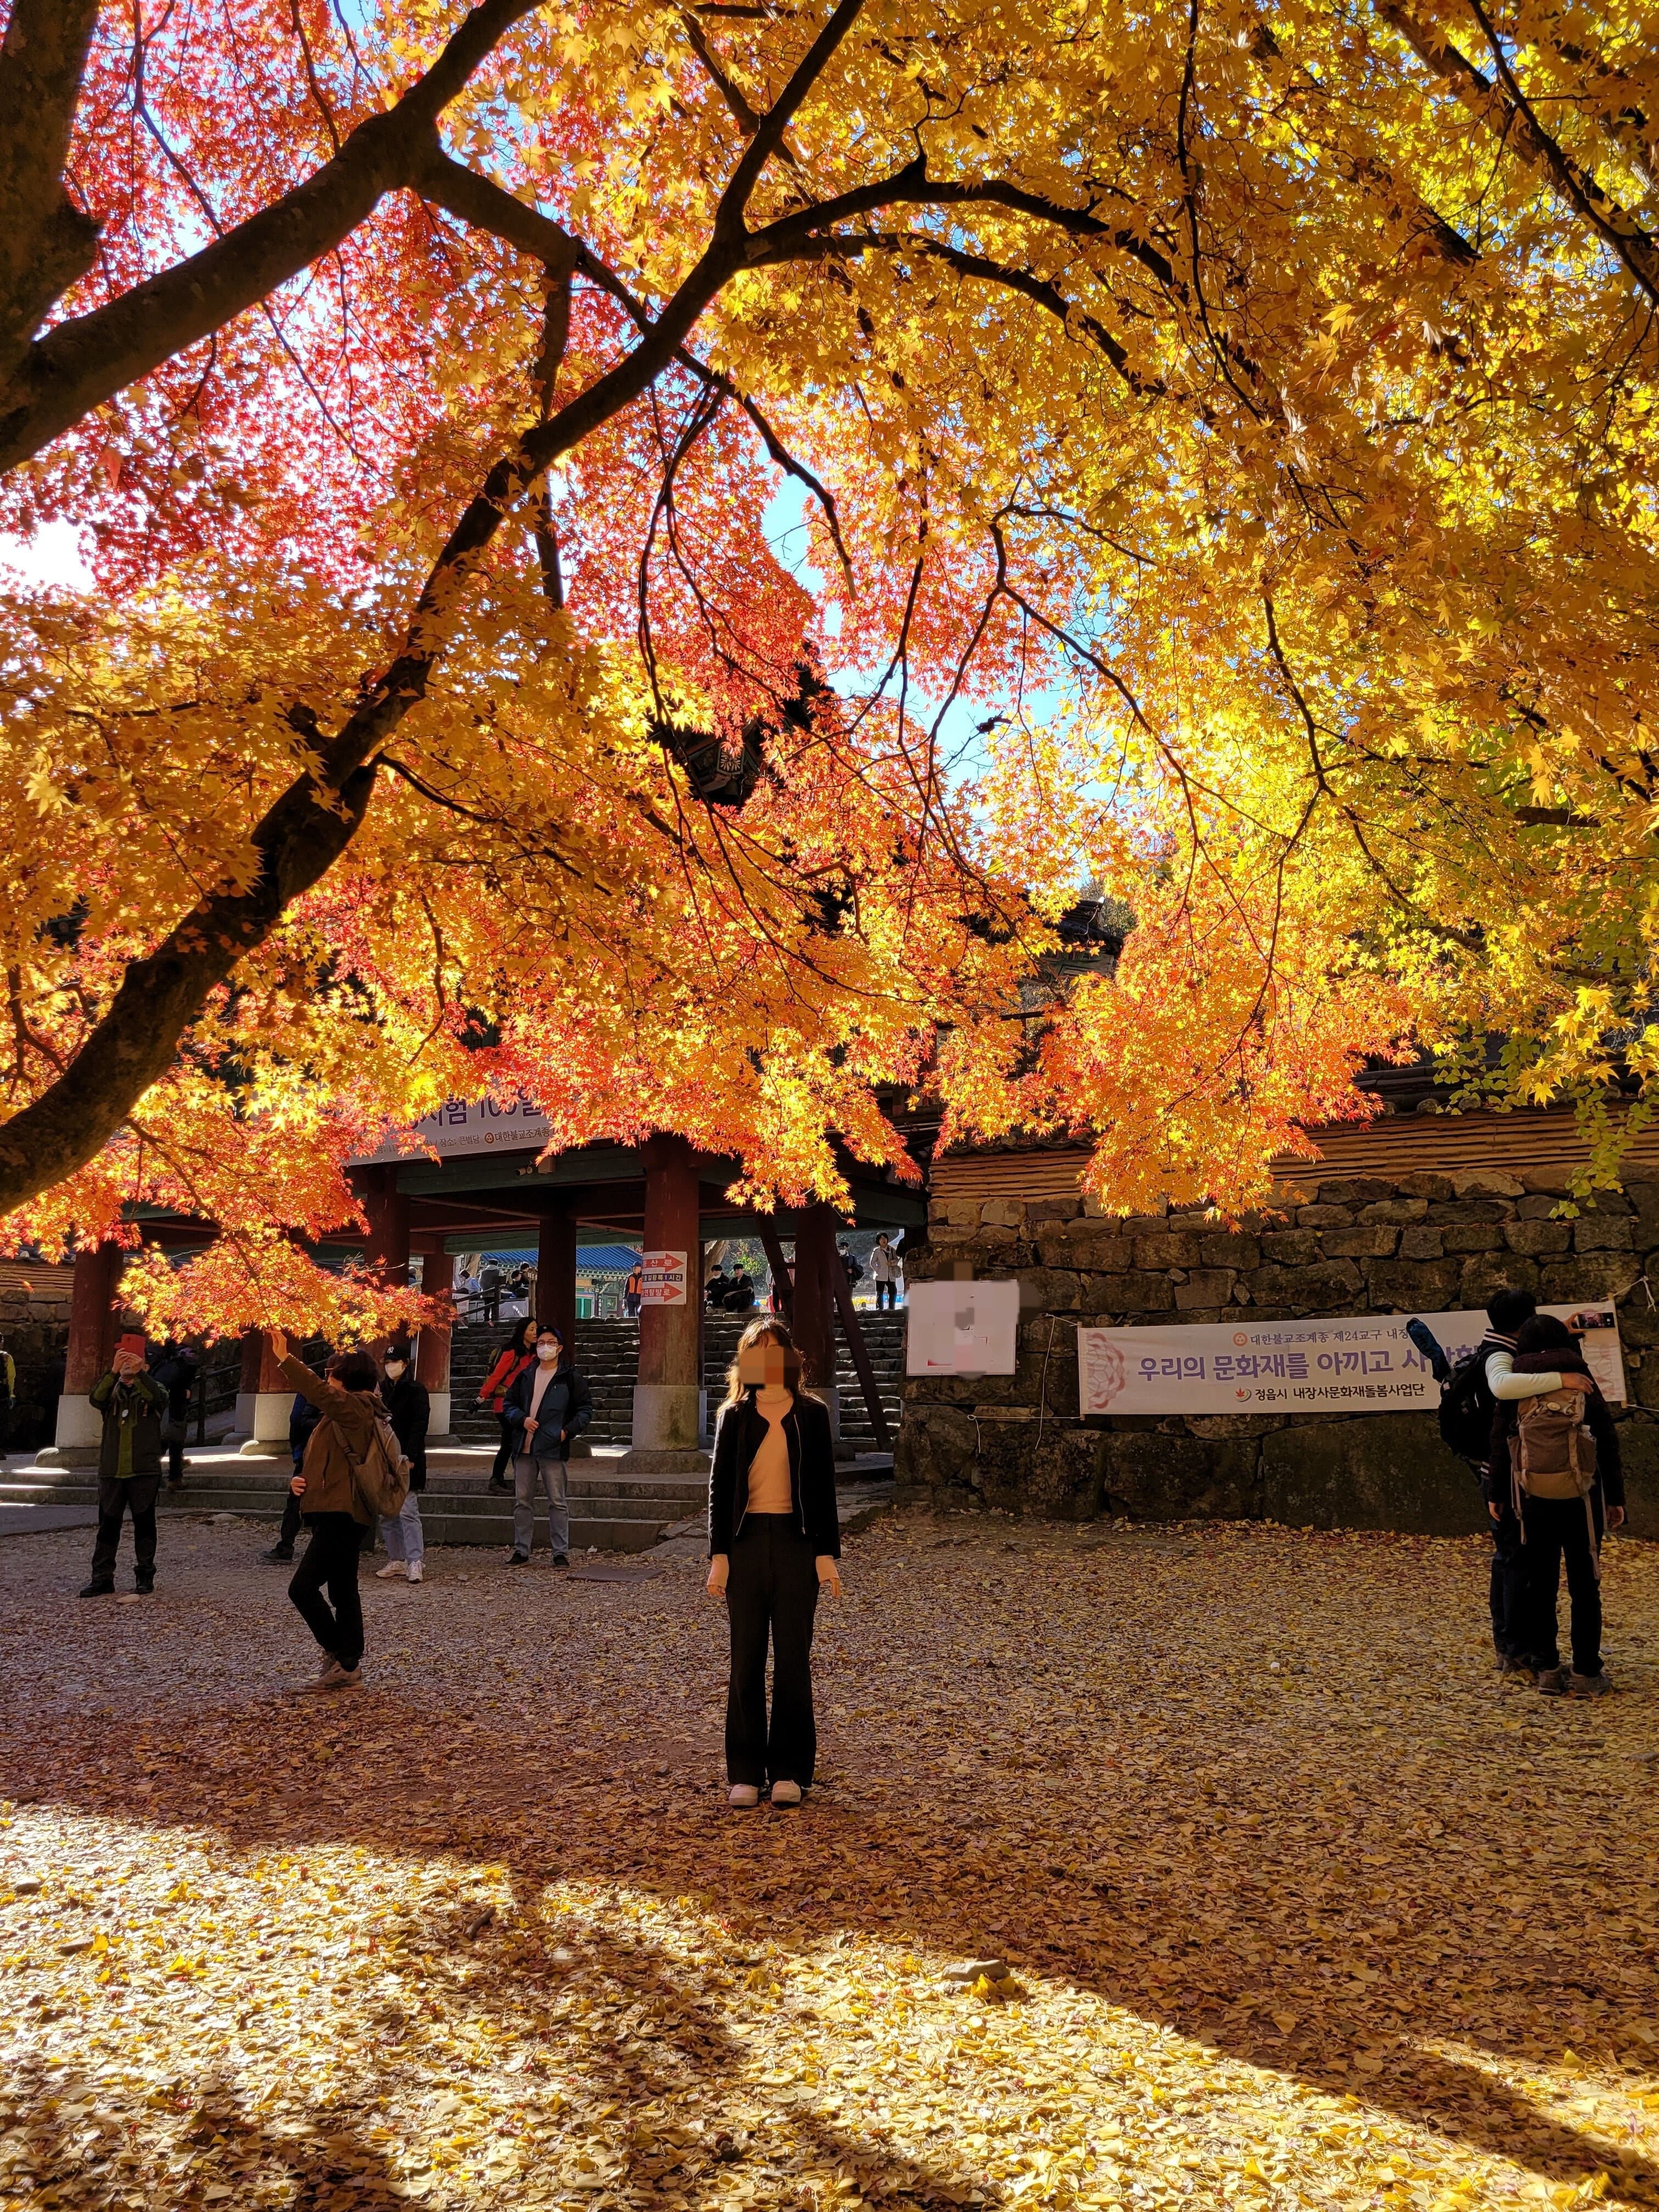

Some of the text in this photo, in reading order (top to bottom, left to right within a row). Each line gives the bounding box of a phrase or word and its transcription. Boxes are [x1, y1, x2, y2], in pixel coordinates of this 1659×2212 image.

[495, 1127, 550, 1142] 대한불교조계종
[1250, 1331, 1329, 1345] 대한불교조계종
[1333, 1329, 1382, 1342] 제24교구
[1138, 1357, 1205, 1381] 우리의
[1213, 1352, 1310, 1381] 문화재를
[1317, 1350, 1394, 1376] 아끼고
[1255, 1383, 1425, 1401] 정읍시 내장사문화재돌봄사업단
